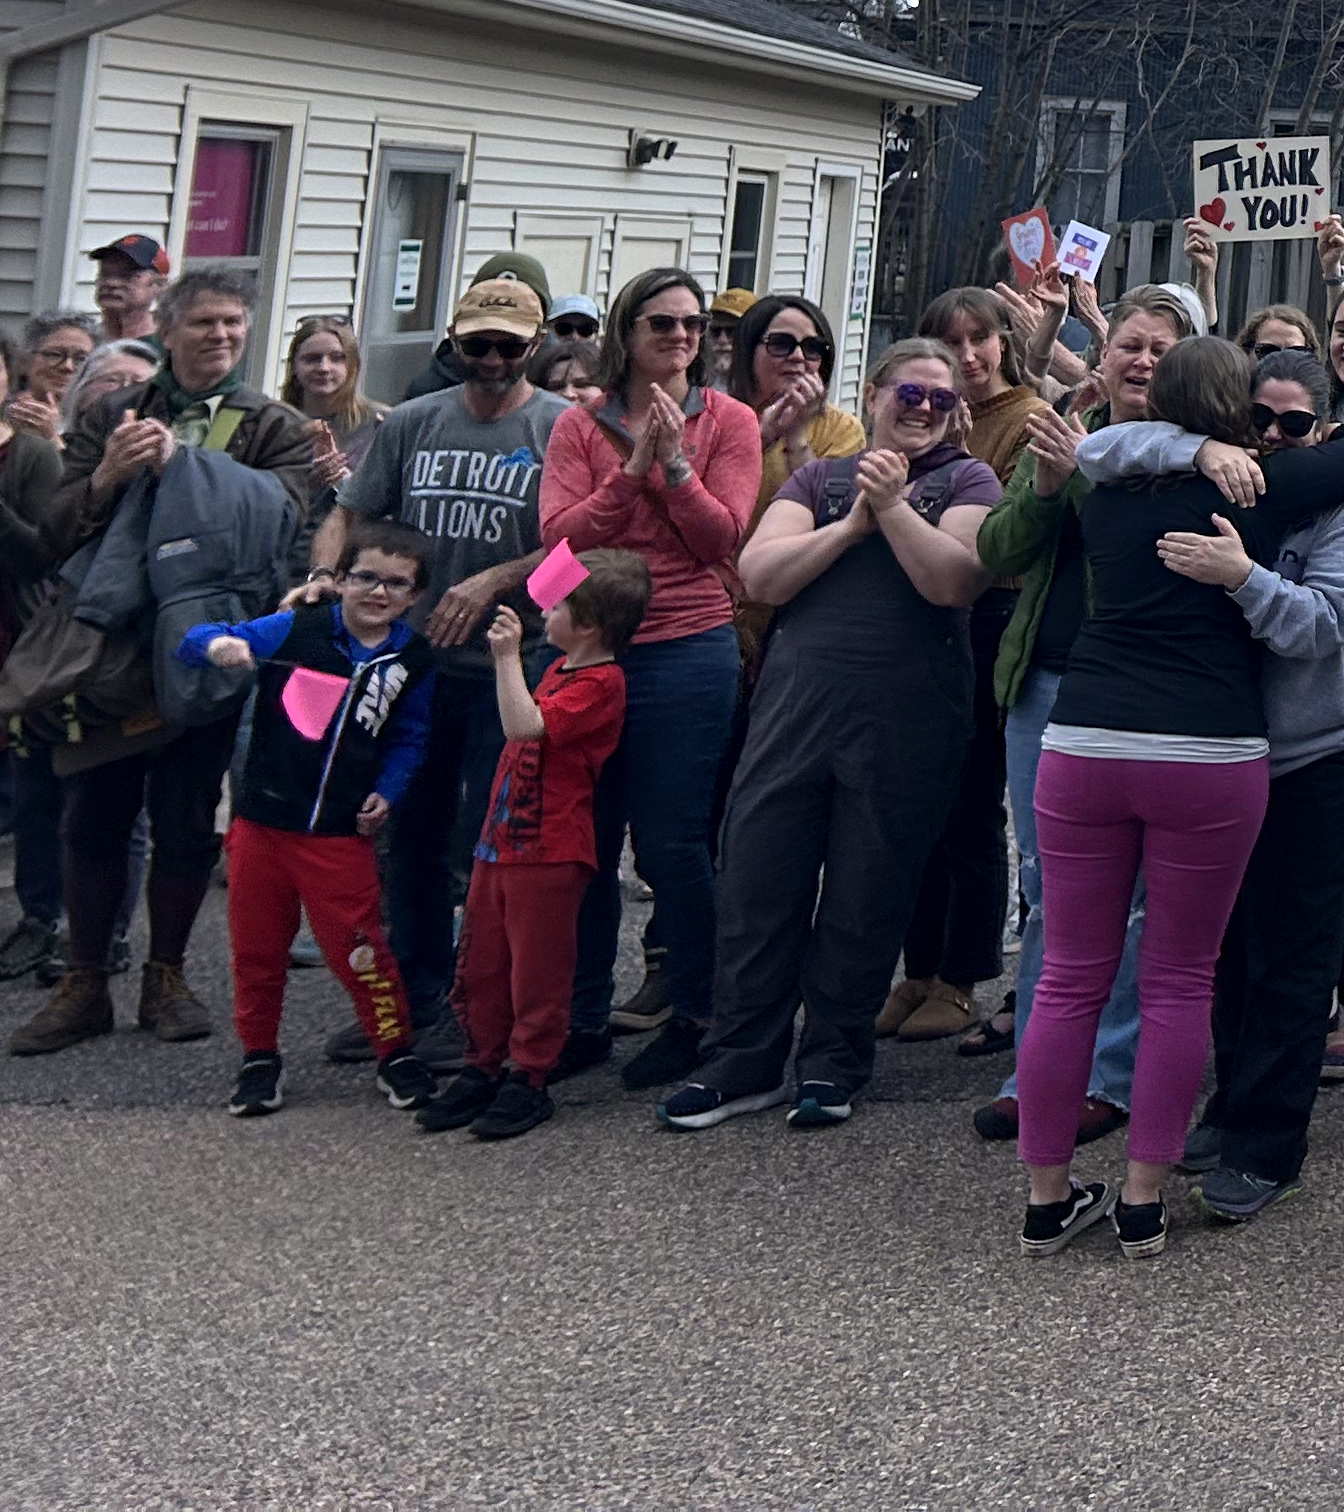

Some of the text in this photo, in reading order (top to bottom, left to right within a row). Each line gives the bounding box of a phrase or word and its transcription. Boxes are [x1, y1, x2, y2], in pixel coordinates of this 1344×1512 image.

[1200, 143, 1321, 193] THANK
[1241, 194, 1308, 230] YOU!
[411, 449, 541, 498] DETROIT
[419, 499, 507, 543] LIONS
